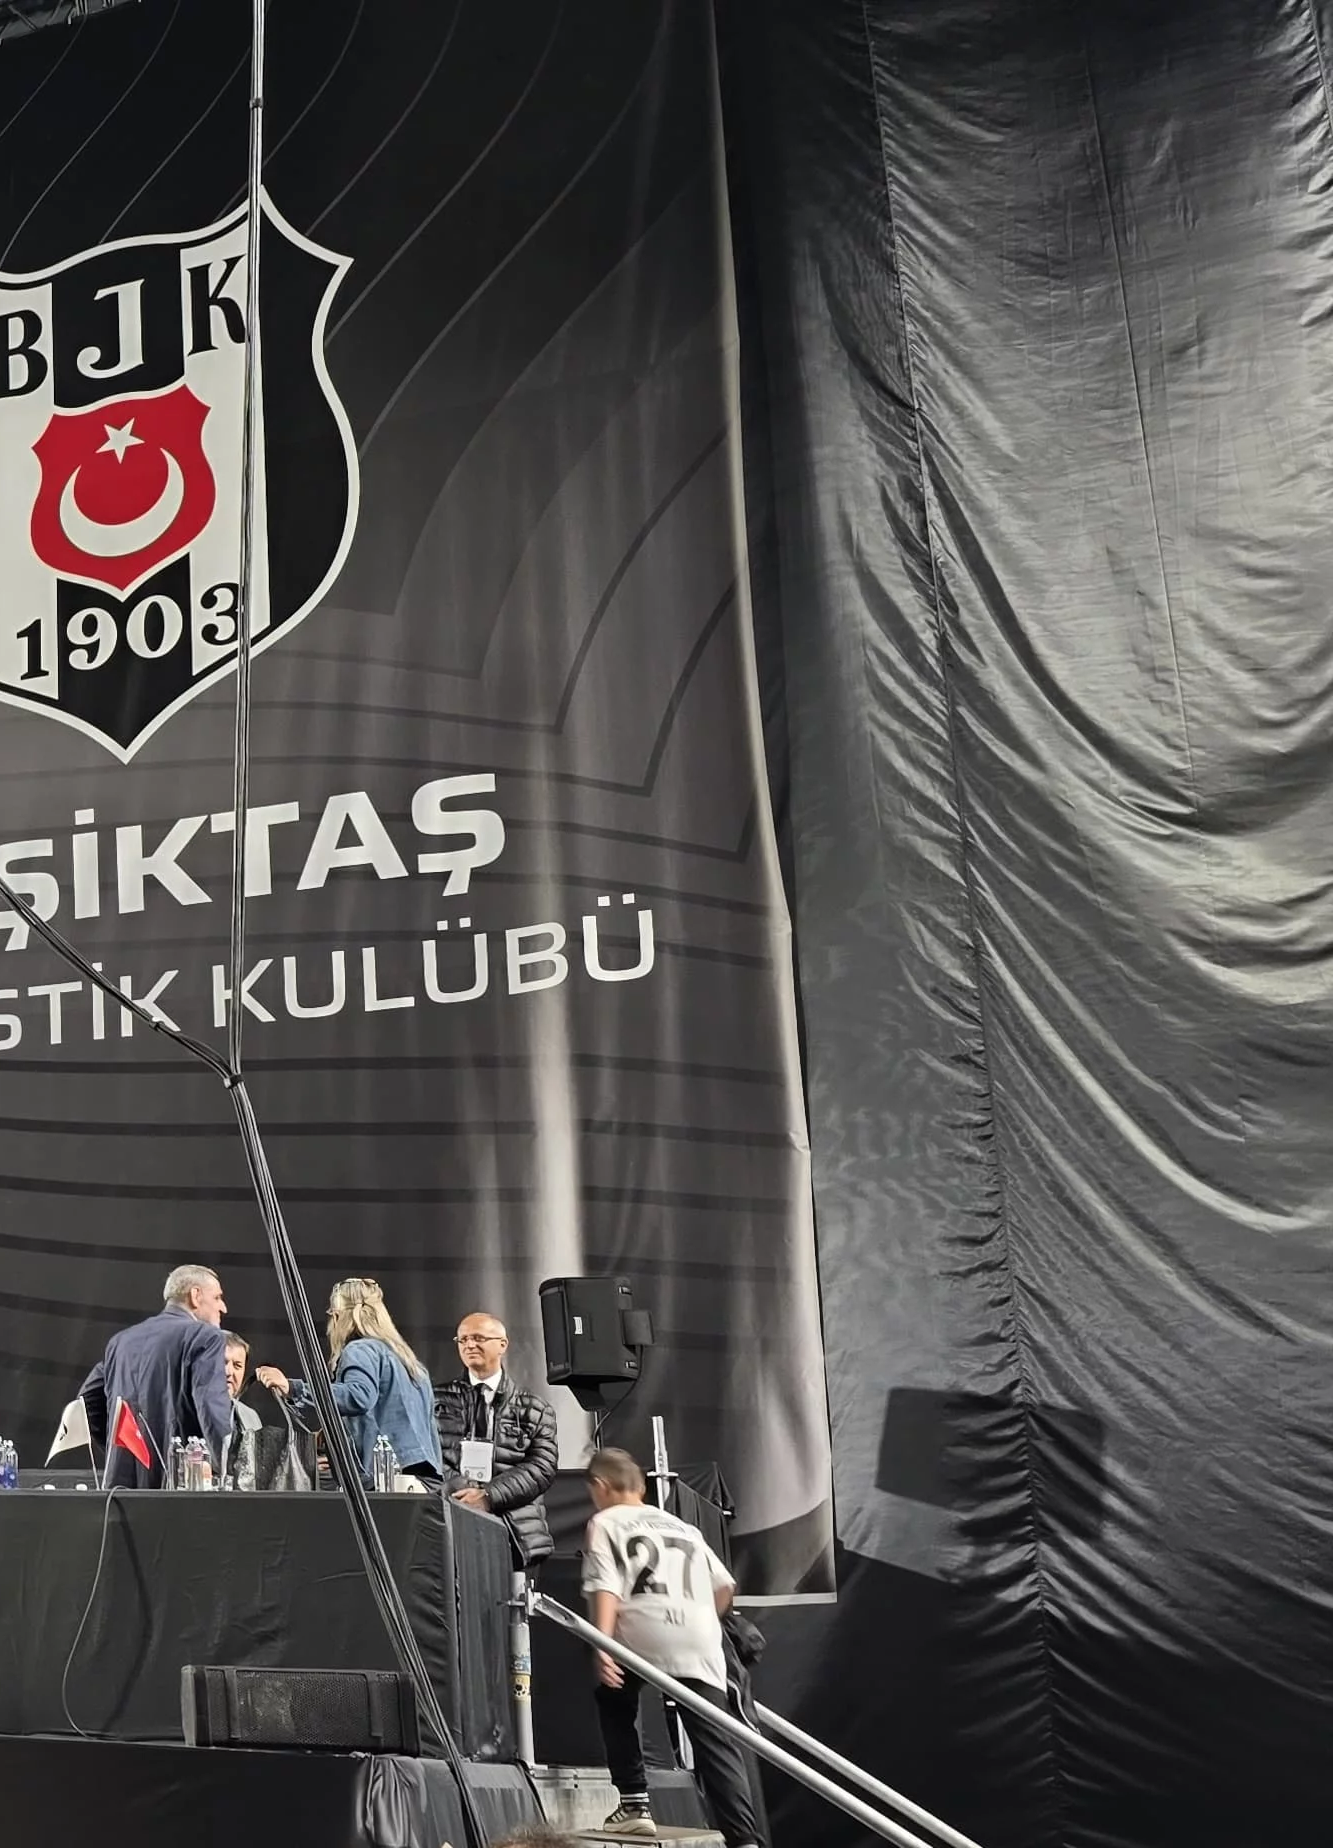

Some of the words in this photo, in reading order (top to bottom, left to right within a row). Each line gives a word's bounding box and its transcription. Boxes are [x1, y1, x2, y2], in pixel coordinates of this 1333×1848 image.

[16, 581, 244, 681] 1903
[211, 892, 656, 1029] KULÜBÜ
[626, 1535, 696, 1601] 27
